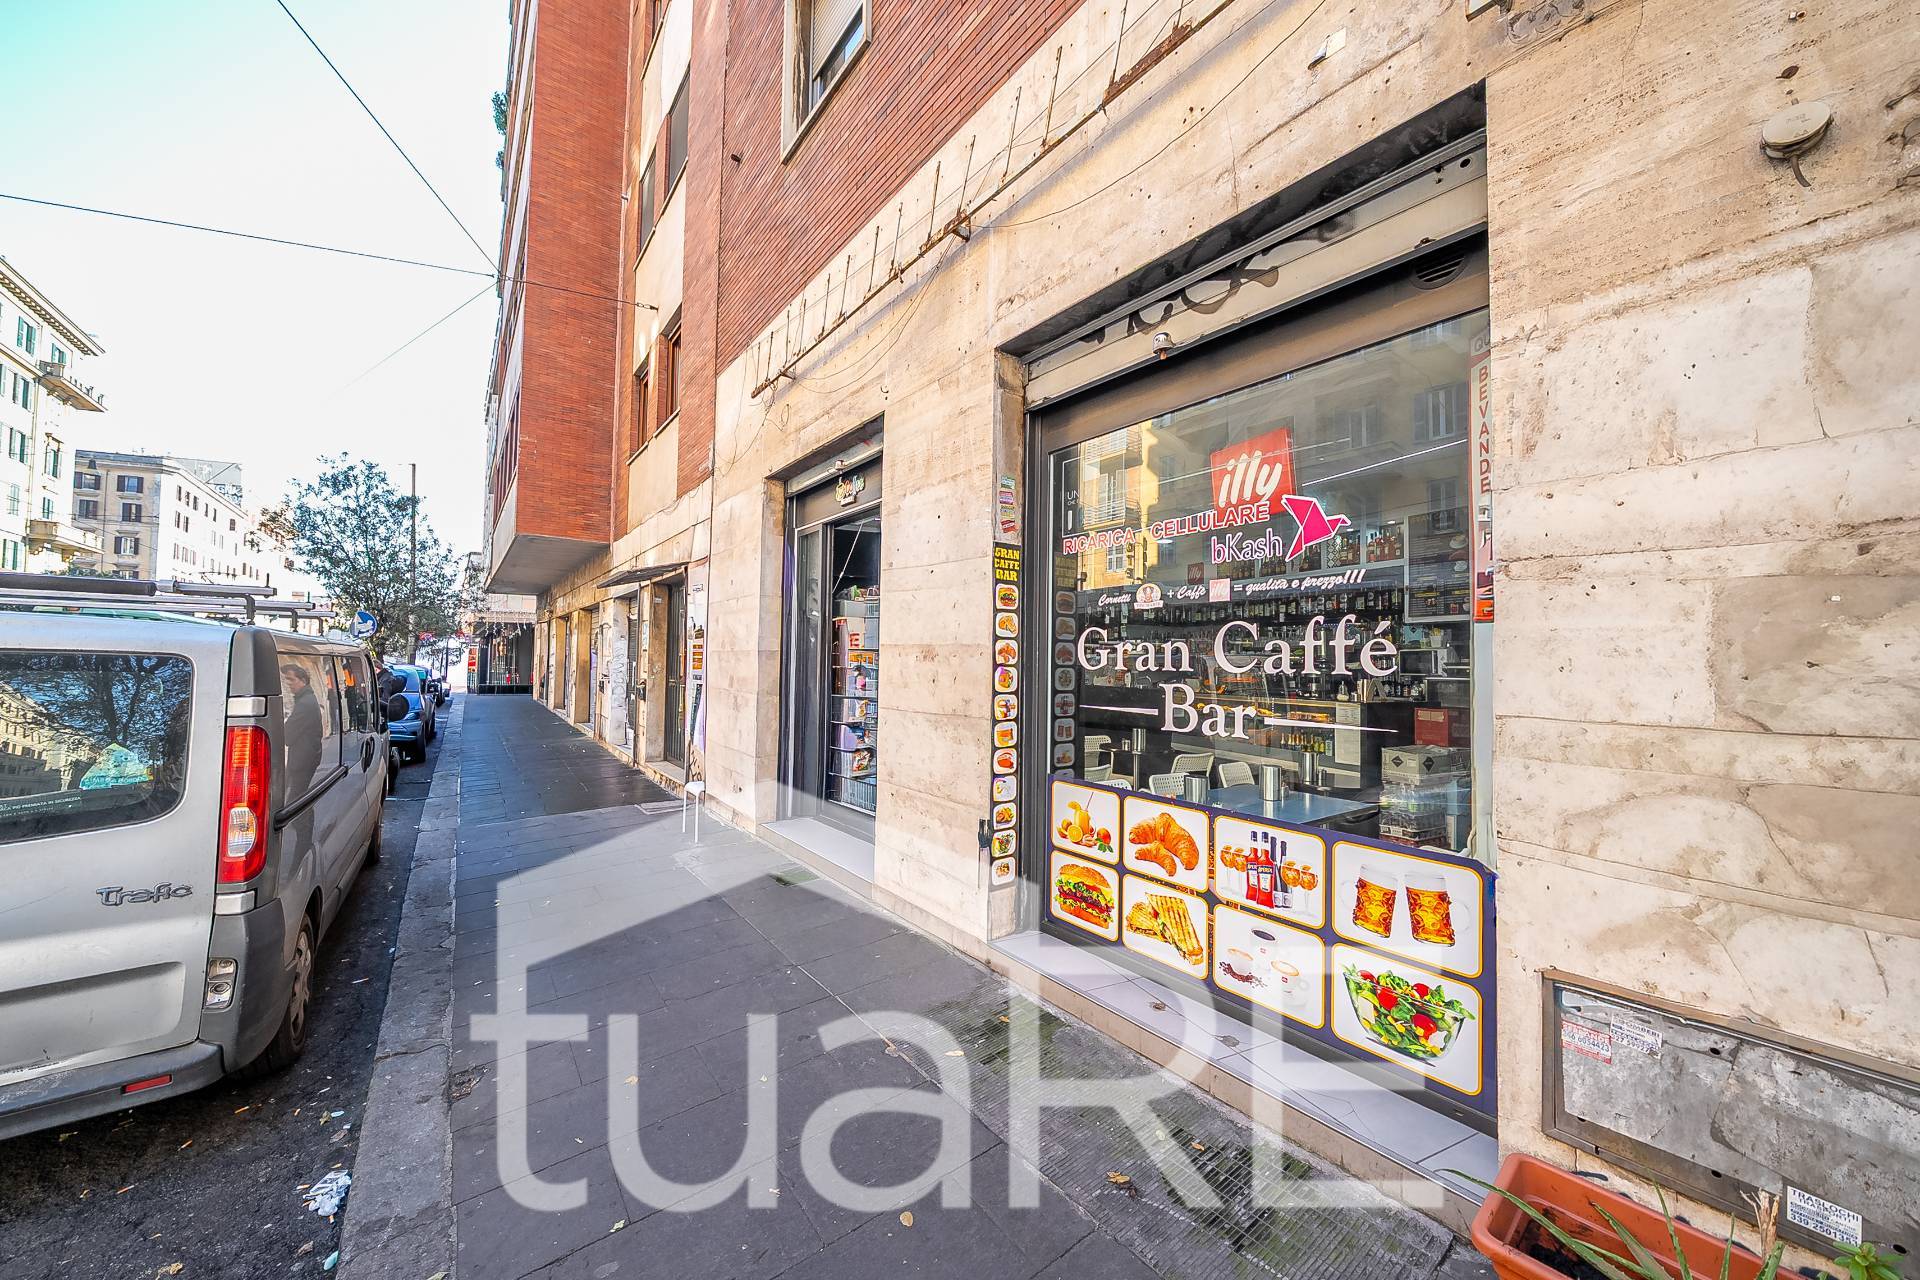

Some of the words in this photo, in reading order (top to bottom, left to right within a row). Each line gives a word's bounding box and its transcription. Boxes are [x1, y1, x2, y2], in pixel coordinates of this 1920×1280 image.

[1478, 365, 1491, 494] BEVANDE
[1218, 450, 1283, 508] illy
[1062, 526, 1136, 555] RICARICA
[1150, 501, 1270, 540] CELLULARE
[1210, 528, 1283, 564] bKash
[994, 547, 1020, 560] GRAN
[995, 569, 1018, 581] BAR
[1098, 593, 1132, 606] Cornetti
[1077, 626, 1194, 672] Gran
[1214, 614, 1398, 677] Caffé
[1159, 683, 1256, 739] Bar
[95, 882, 193, 907] Trafic
[1790, 1188, 1859, 1222] TRASLOCHI
